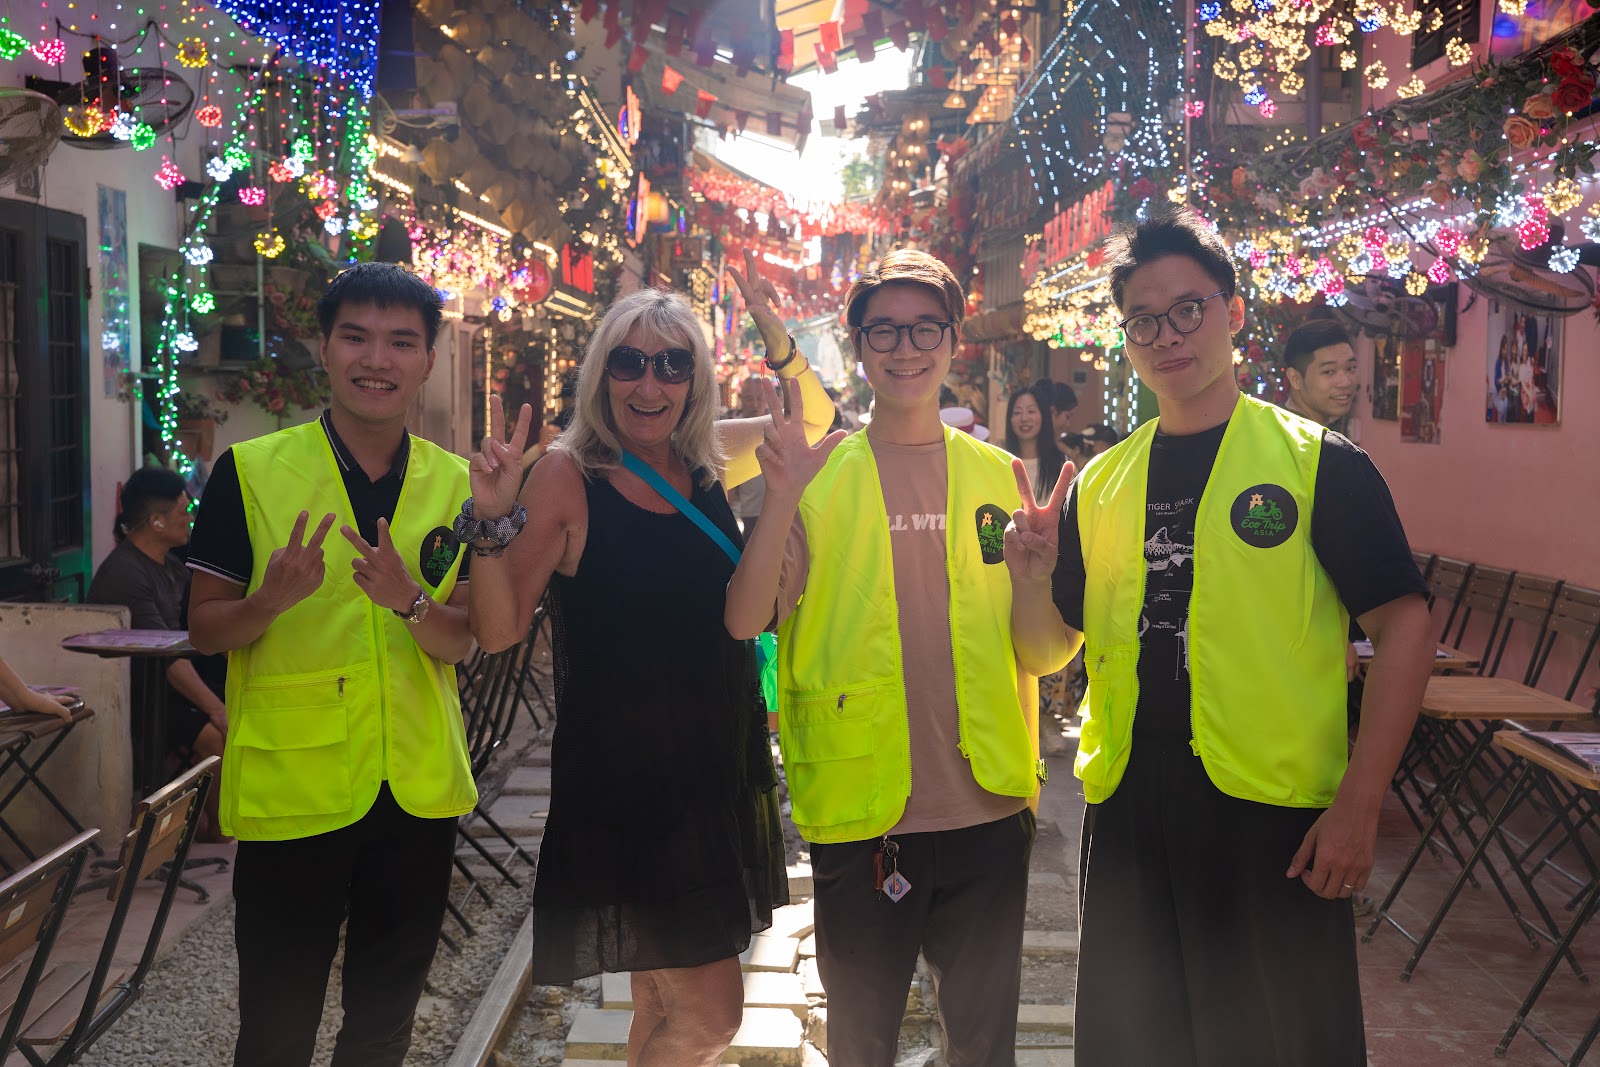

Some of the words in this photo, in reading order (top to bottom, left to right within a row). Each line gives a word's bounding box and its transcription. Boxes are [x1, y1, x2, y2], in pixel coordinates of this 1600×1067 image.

[1147, 503, 1171, 511] TIGER
[1241, 519, 1261, 529] Eco
[1262, 520, 1287, 533] Trip
[1253, 529, 1274, 537] ASIA
[983, 546, 997, 555] ASIA
